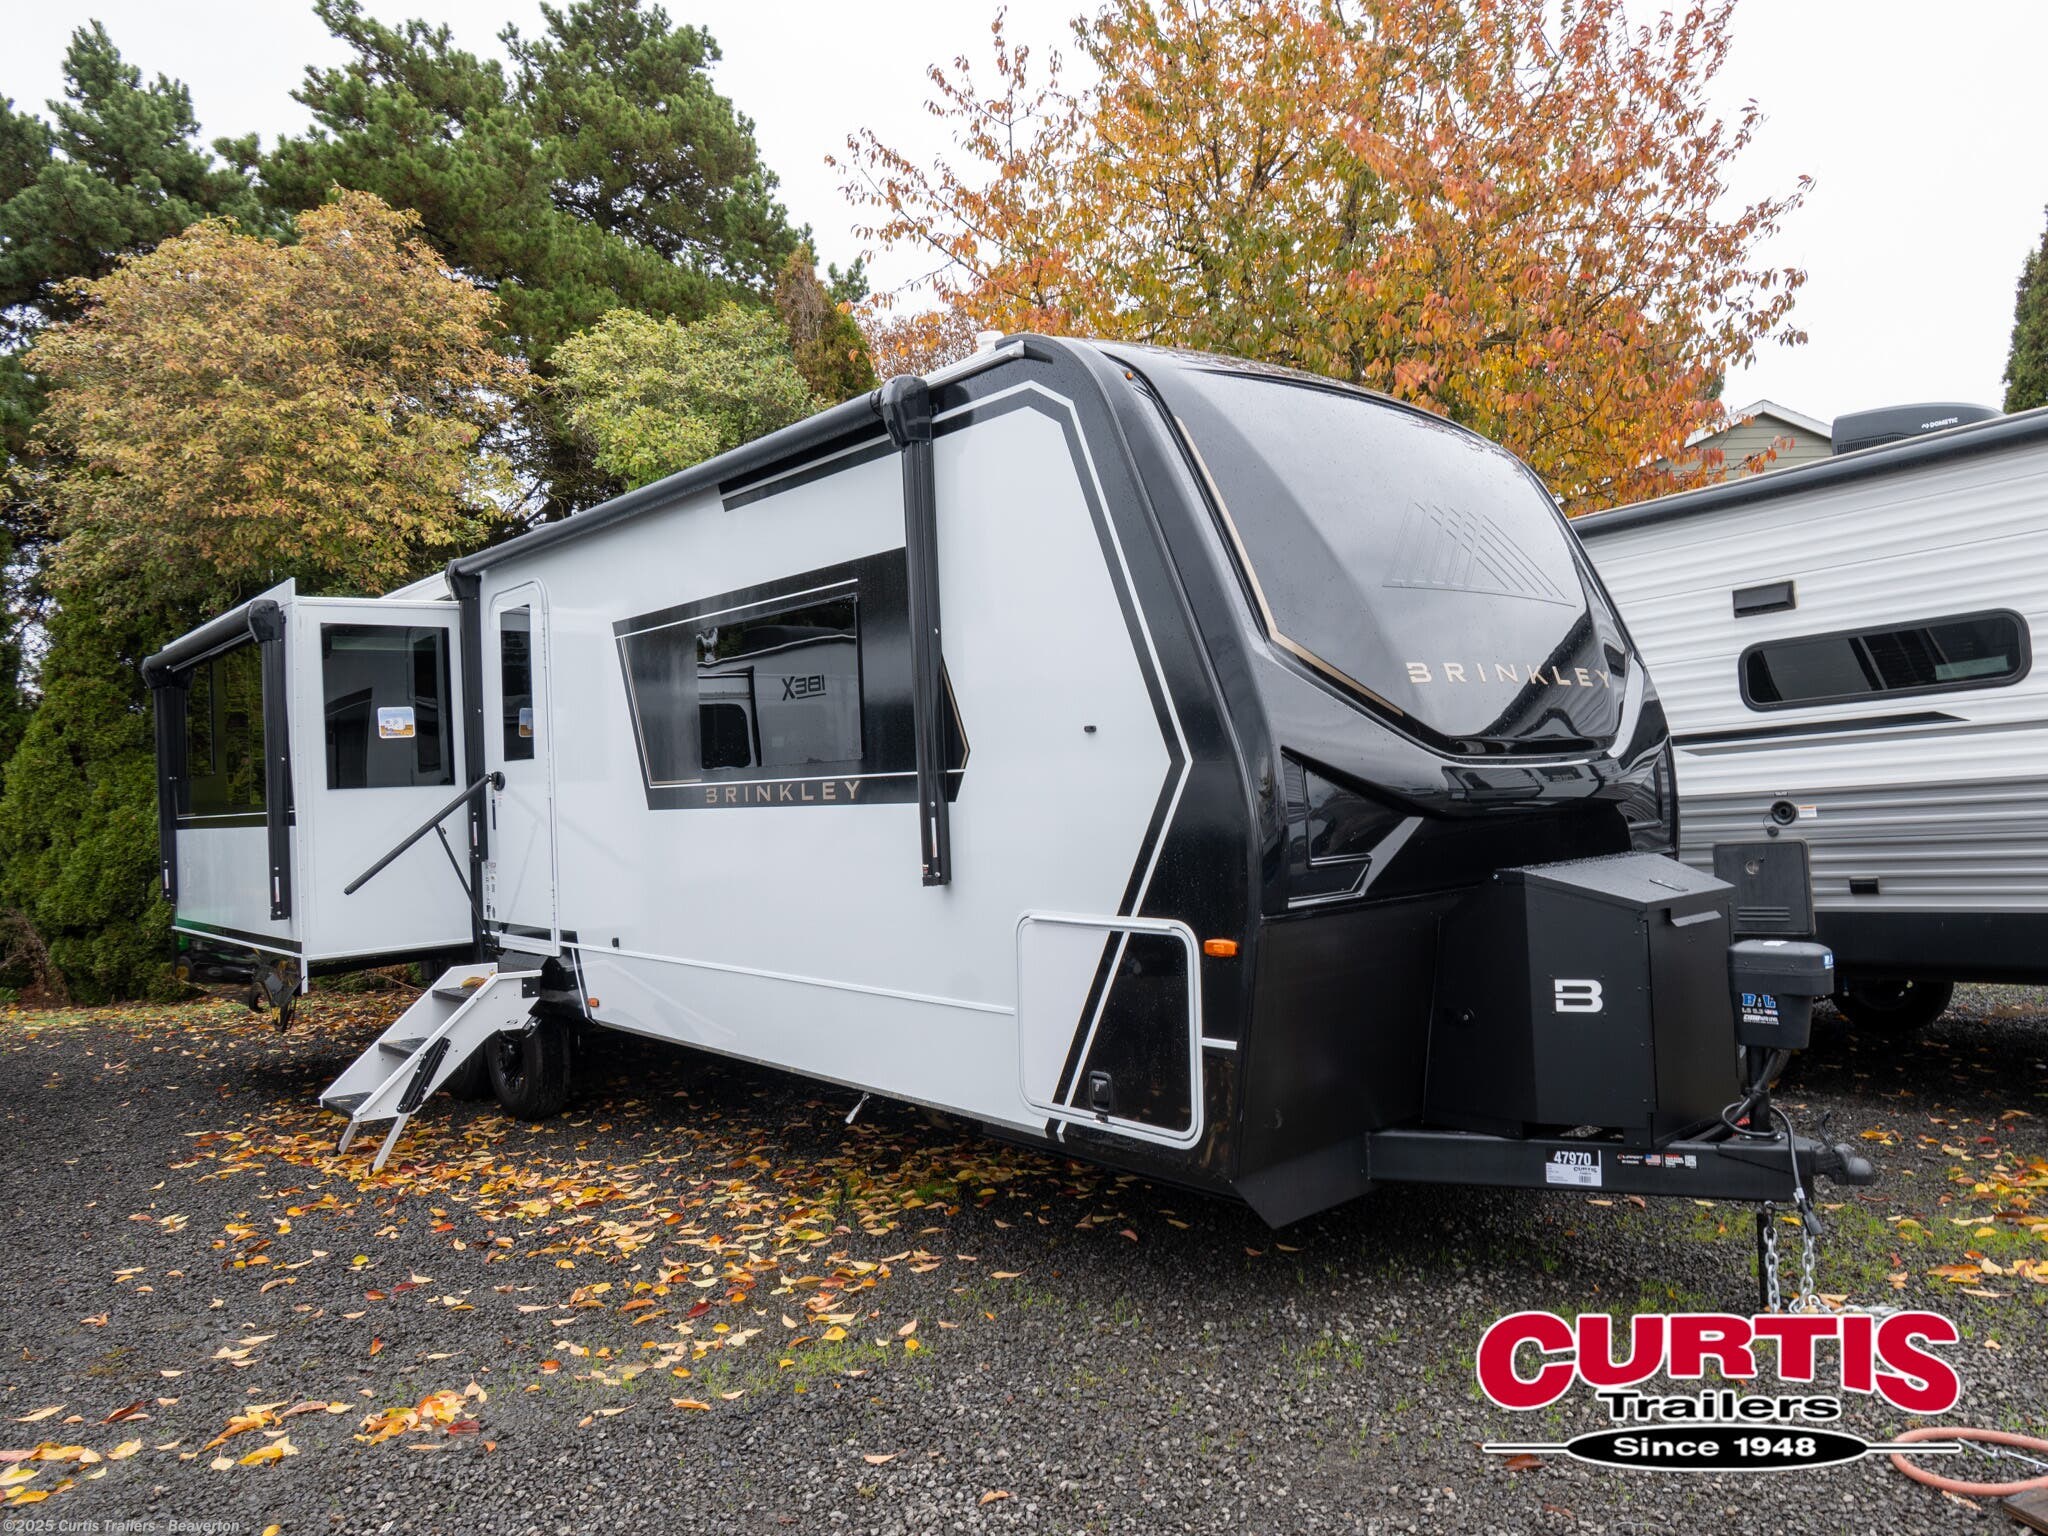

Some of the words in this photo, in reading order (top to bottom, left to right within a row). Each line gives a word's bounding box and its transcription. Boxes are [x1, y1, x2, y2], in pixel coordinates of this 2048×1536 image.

[1405, 661, 1610, 689] BRINKLEY
[705, 780, 860, 804] BRINKLEY
[1553, 1150, 1592, 1166] 47970
